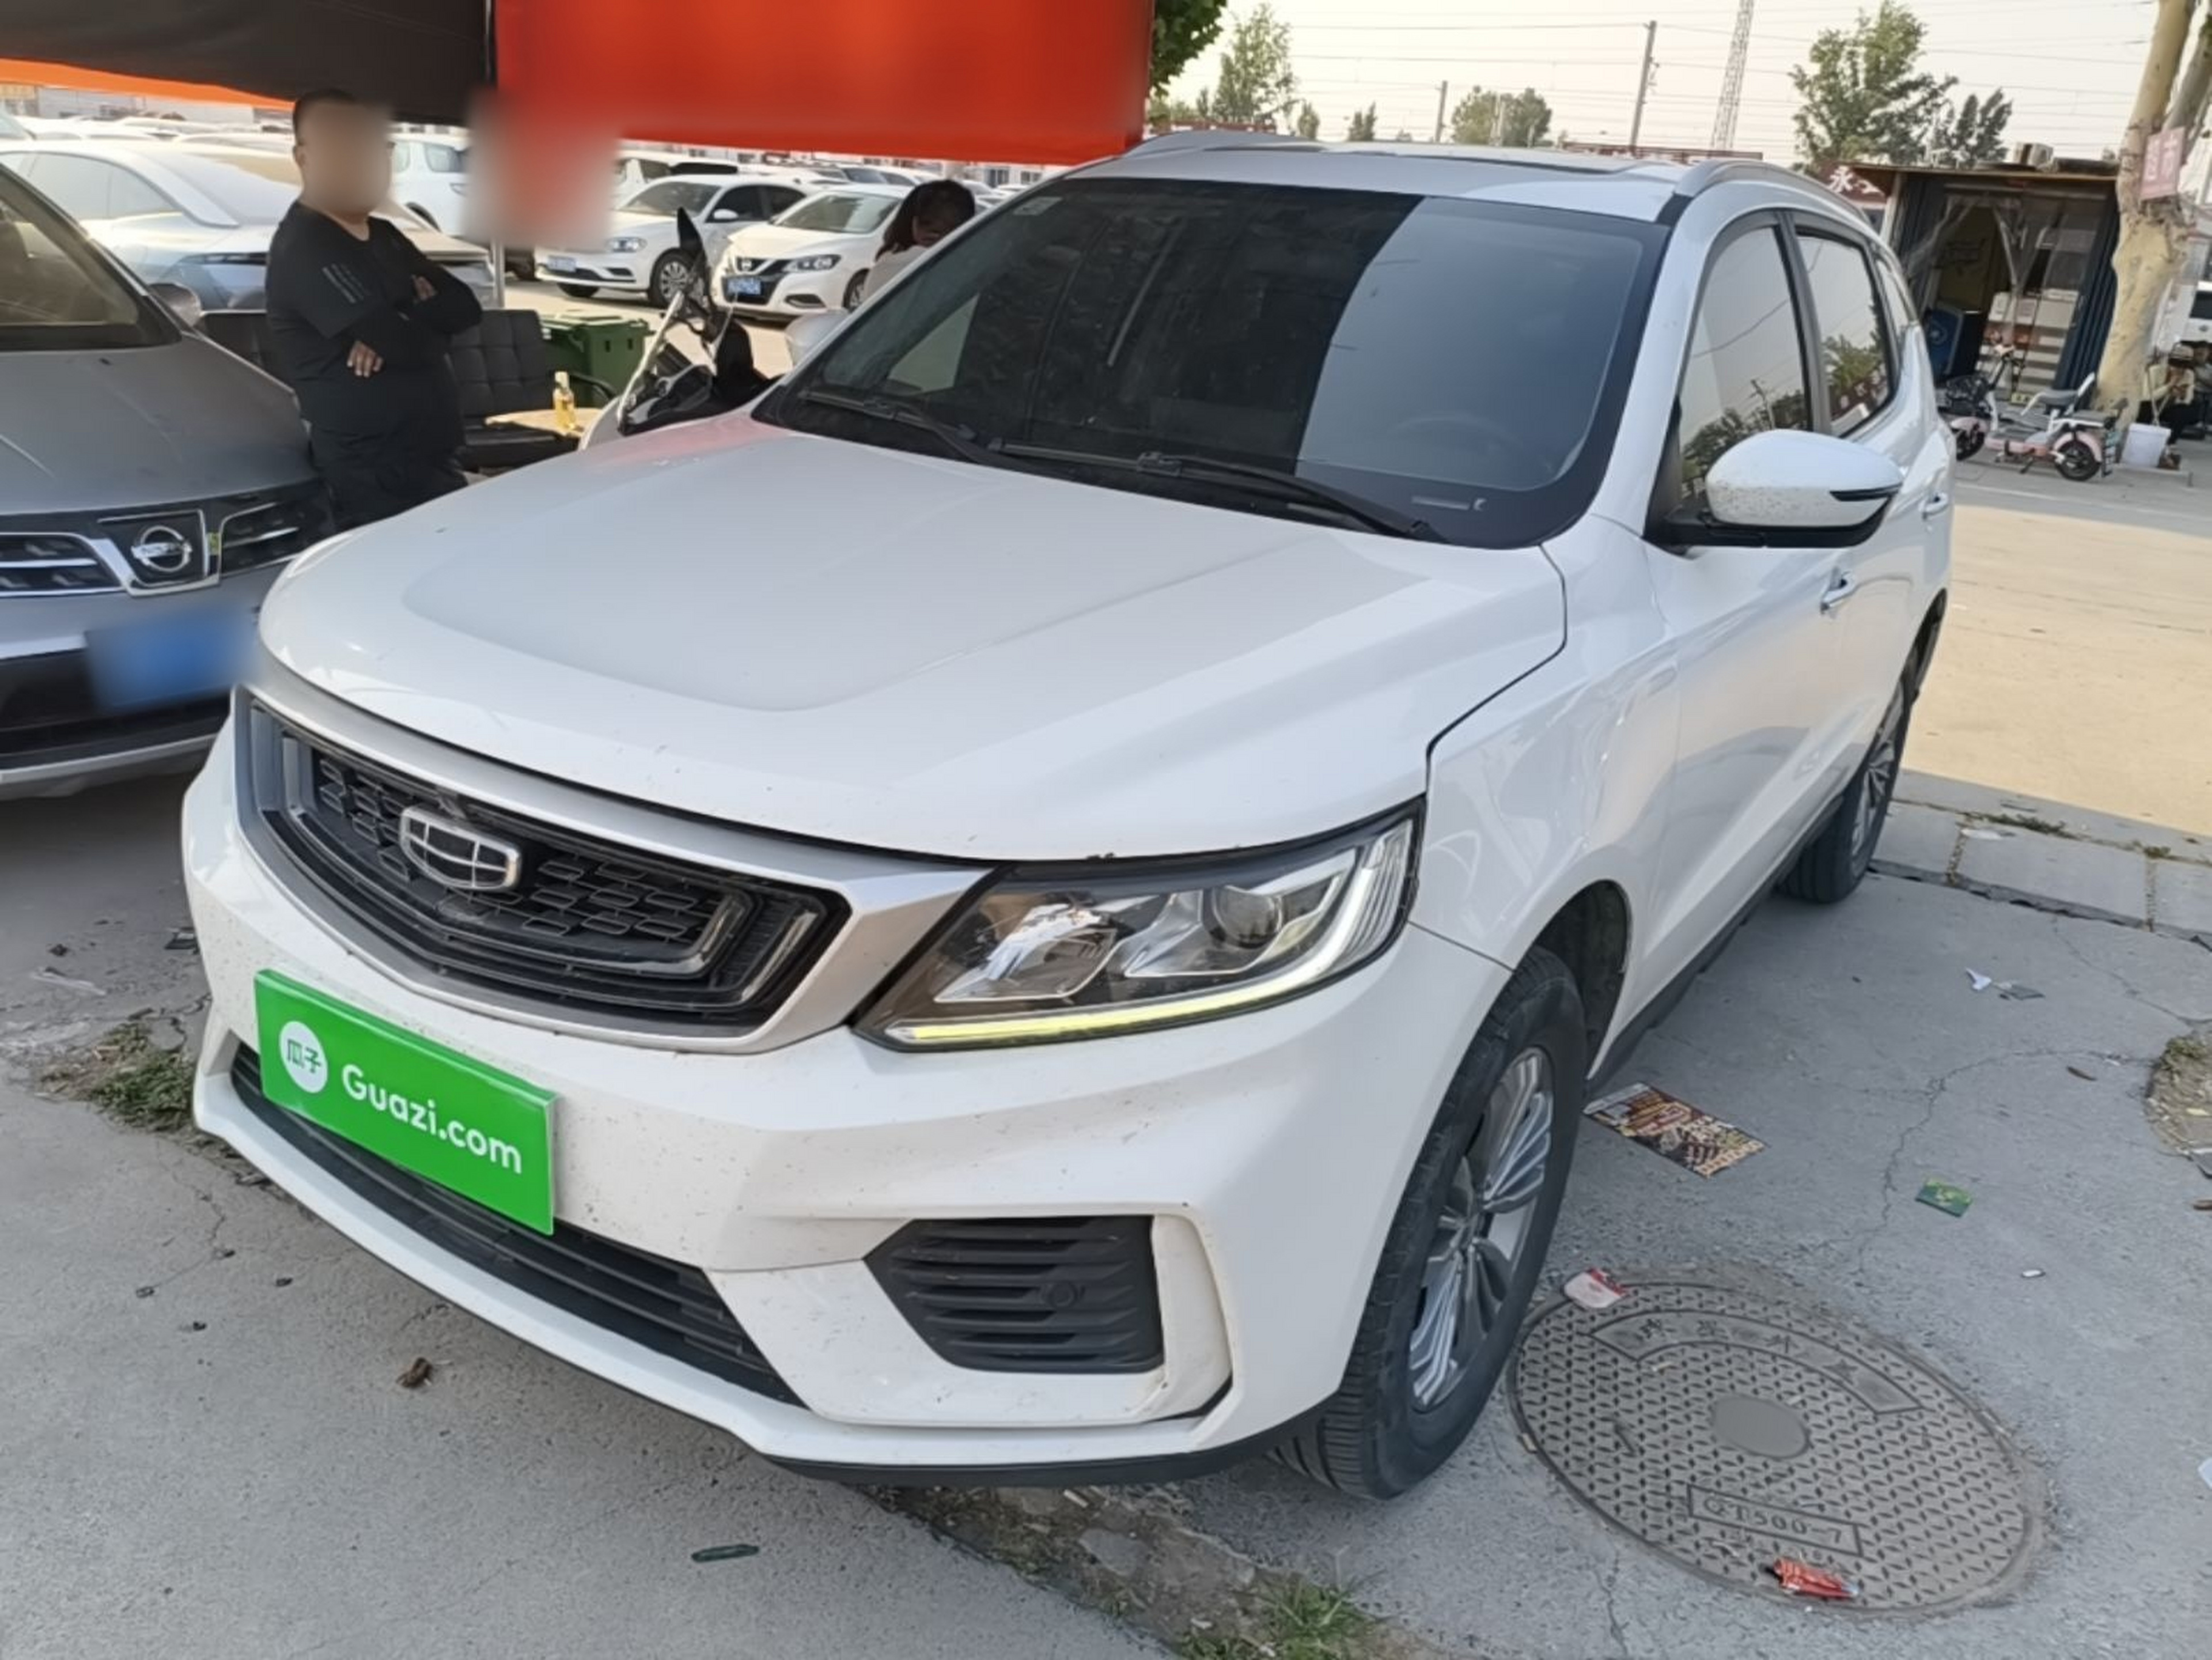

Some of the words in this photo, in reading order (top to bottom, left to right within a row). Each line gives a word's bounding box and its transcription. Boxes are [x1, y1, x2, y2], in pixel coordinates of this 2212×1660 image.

[287, 1038, 321, 1073] 瓜子
[342, 1064, 522, 1174] Guazi.com
[1703, 1499, 1842, 1544] QT500-7
